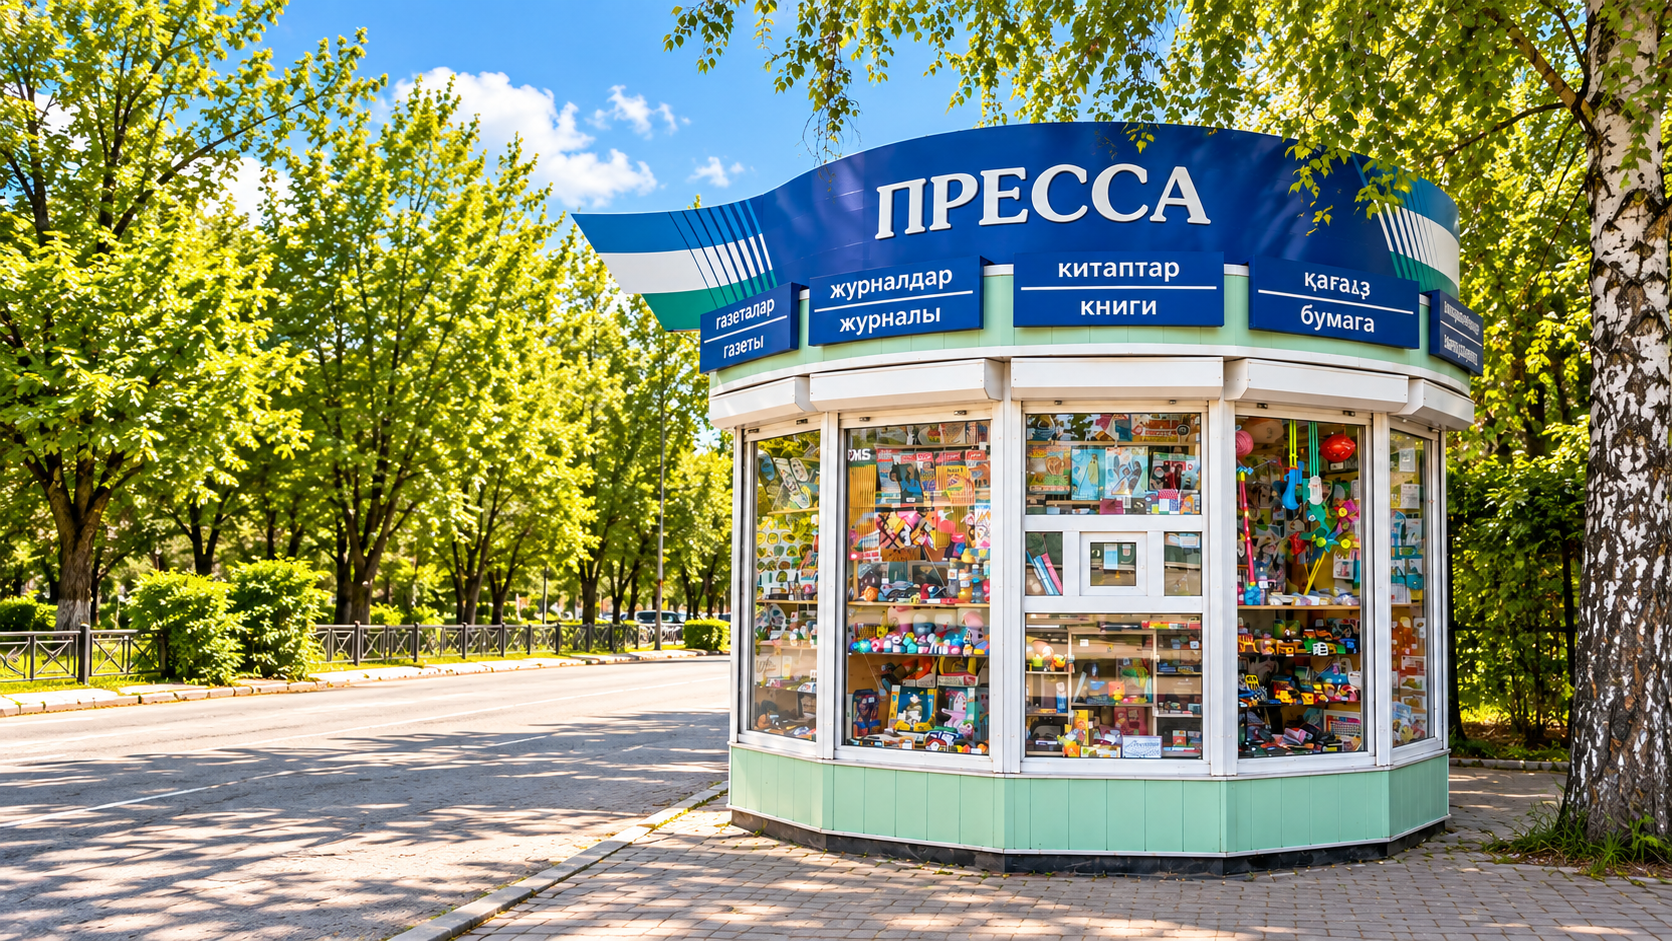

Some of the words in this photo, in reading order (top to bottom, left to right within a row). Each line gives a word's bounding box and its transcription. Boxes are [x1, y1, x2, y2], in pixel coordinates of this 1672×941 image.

[875, 163, 1212, 240] ПРЕССА
[830, 269, 953, 301] журналдар
[1058, 261, 1180, 283] китаптар
[716, 297, 775, 330] газеталар
[839, 307, 941, 336] журналы
[1080, 300, 1157, 316] книги
[1300, 304, 1375, 333] бумага
[723, 335, 764, 359] газеты
